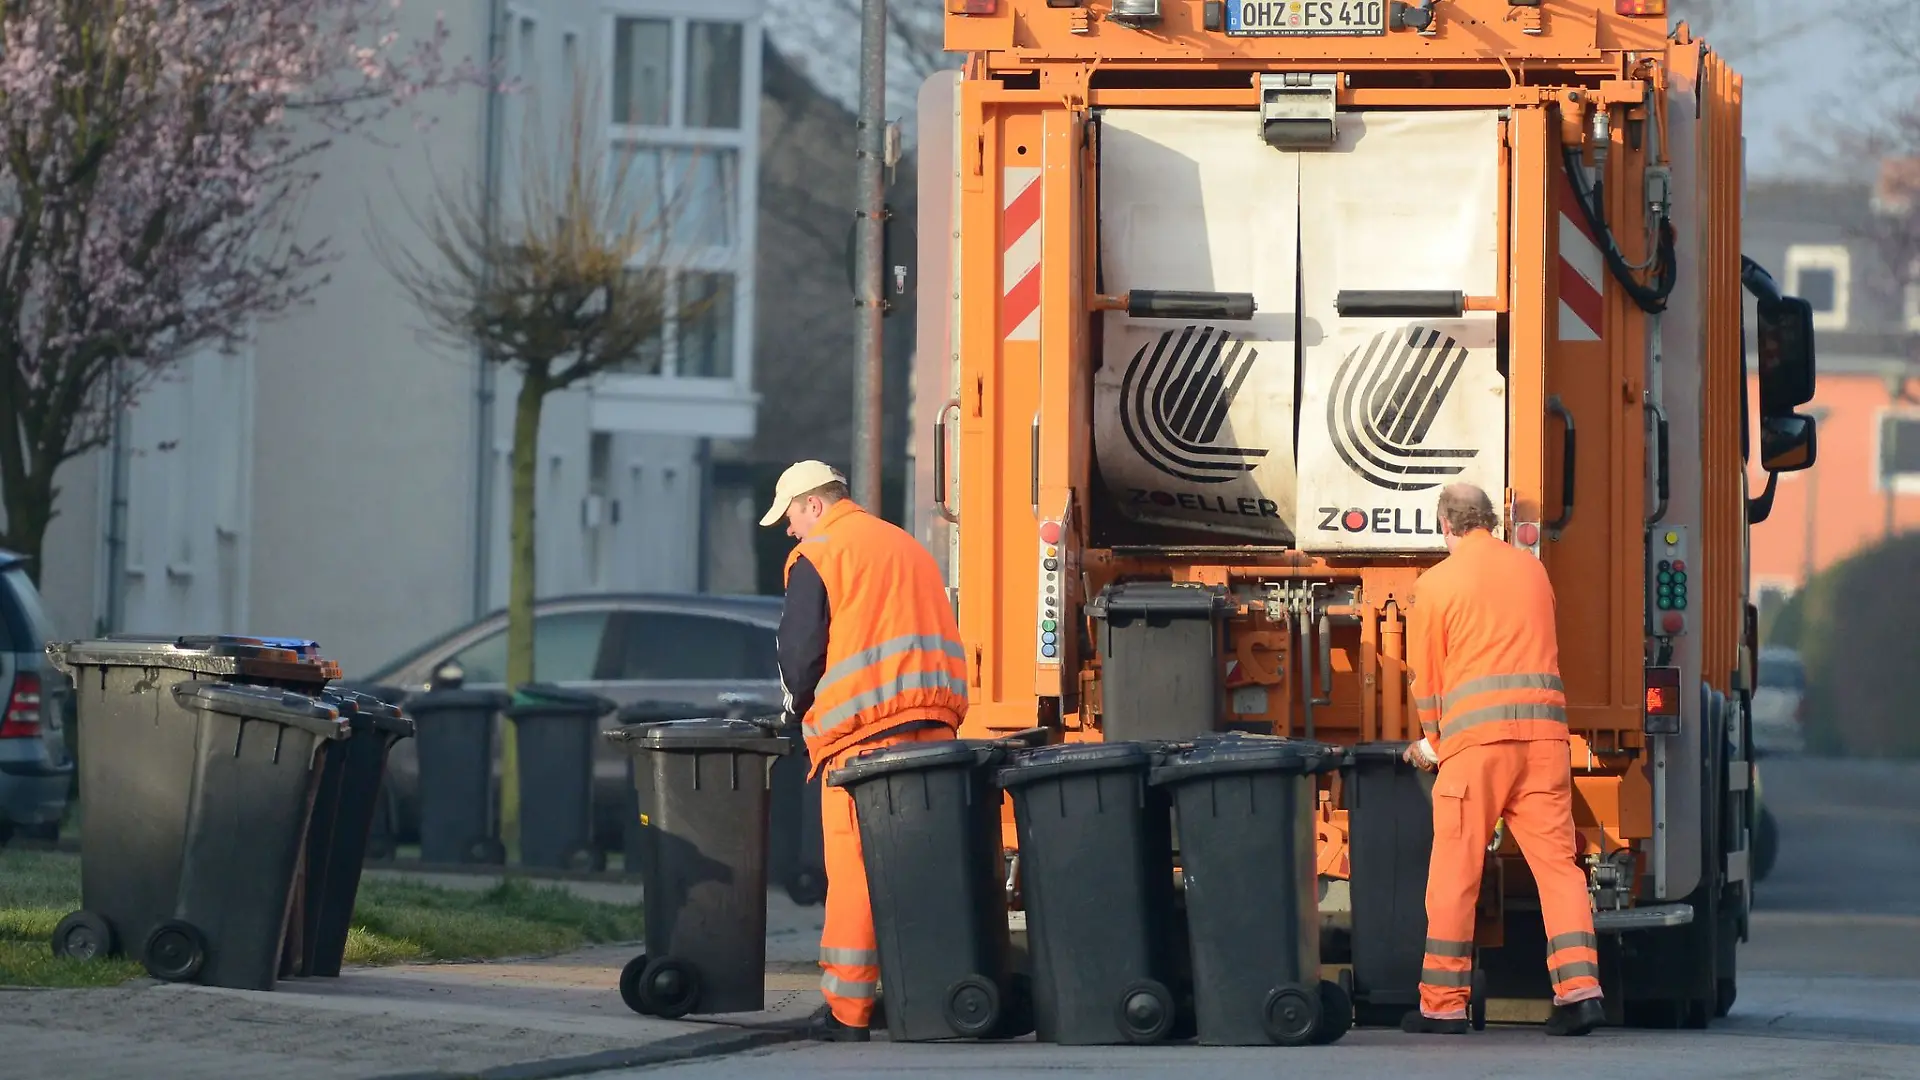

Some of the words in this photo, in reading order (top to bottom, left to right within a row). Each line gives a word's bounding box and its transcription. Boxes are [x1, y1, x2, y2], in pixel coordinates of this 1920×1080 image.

[1231, 17, 1237, 25] D
[1243, 2, 1286, 26] OHZ
[1304, 2, 1333, 26] FS
[1339, 2, 1380, 26] 410
[1127, 488, 1281, 519] ZOELLER
[1317, 507, 1443, 534] ZOELL
